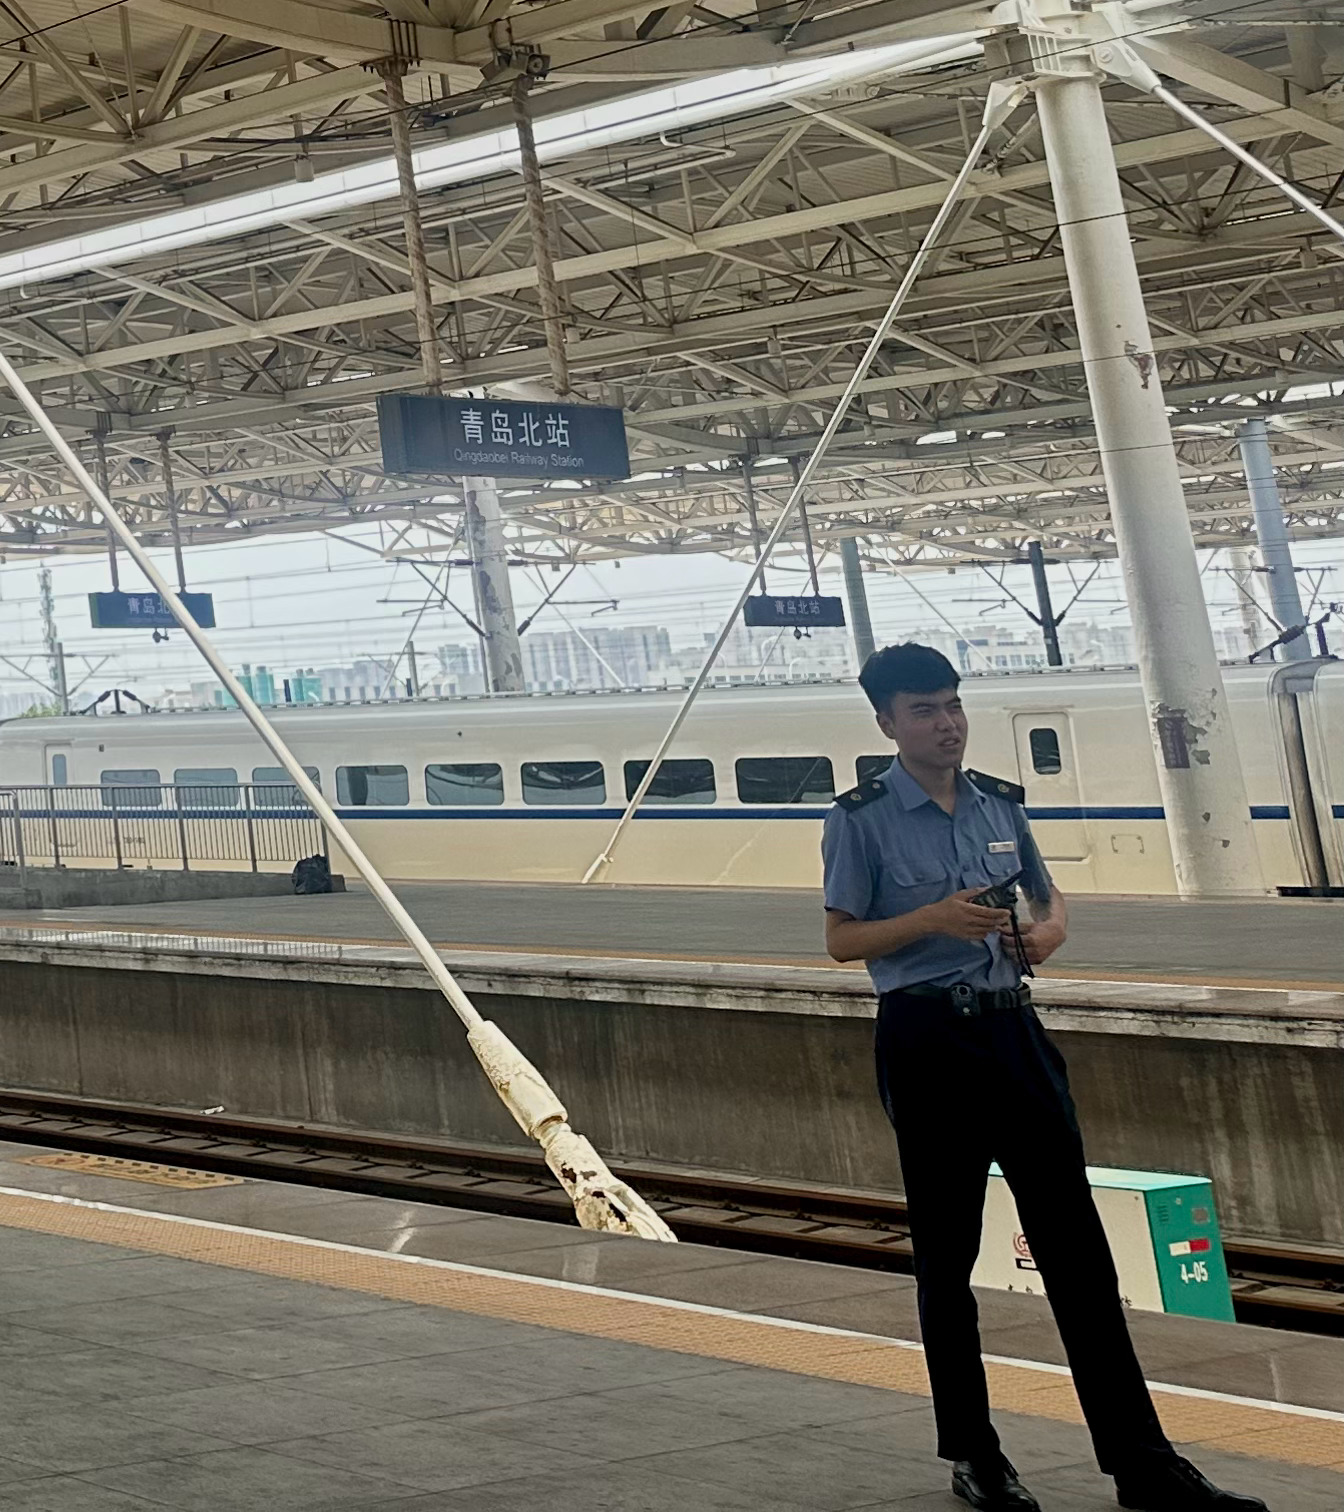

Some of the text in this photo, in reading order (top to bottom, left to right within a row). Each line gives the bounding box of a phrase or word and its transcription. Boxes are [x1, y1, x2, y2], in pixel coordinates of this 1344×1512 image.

[460, 407, 570, 448] 青岛北站
[454, 448, 585, 468] Qingdaobei Railway Station
[127, 594, 170, 615] 青岛北
[1179, 1260, 1209, 1285] 4-05
